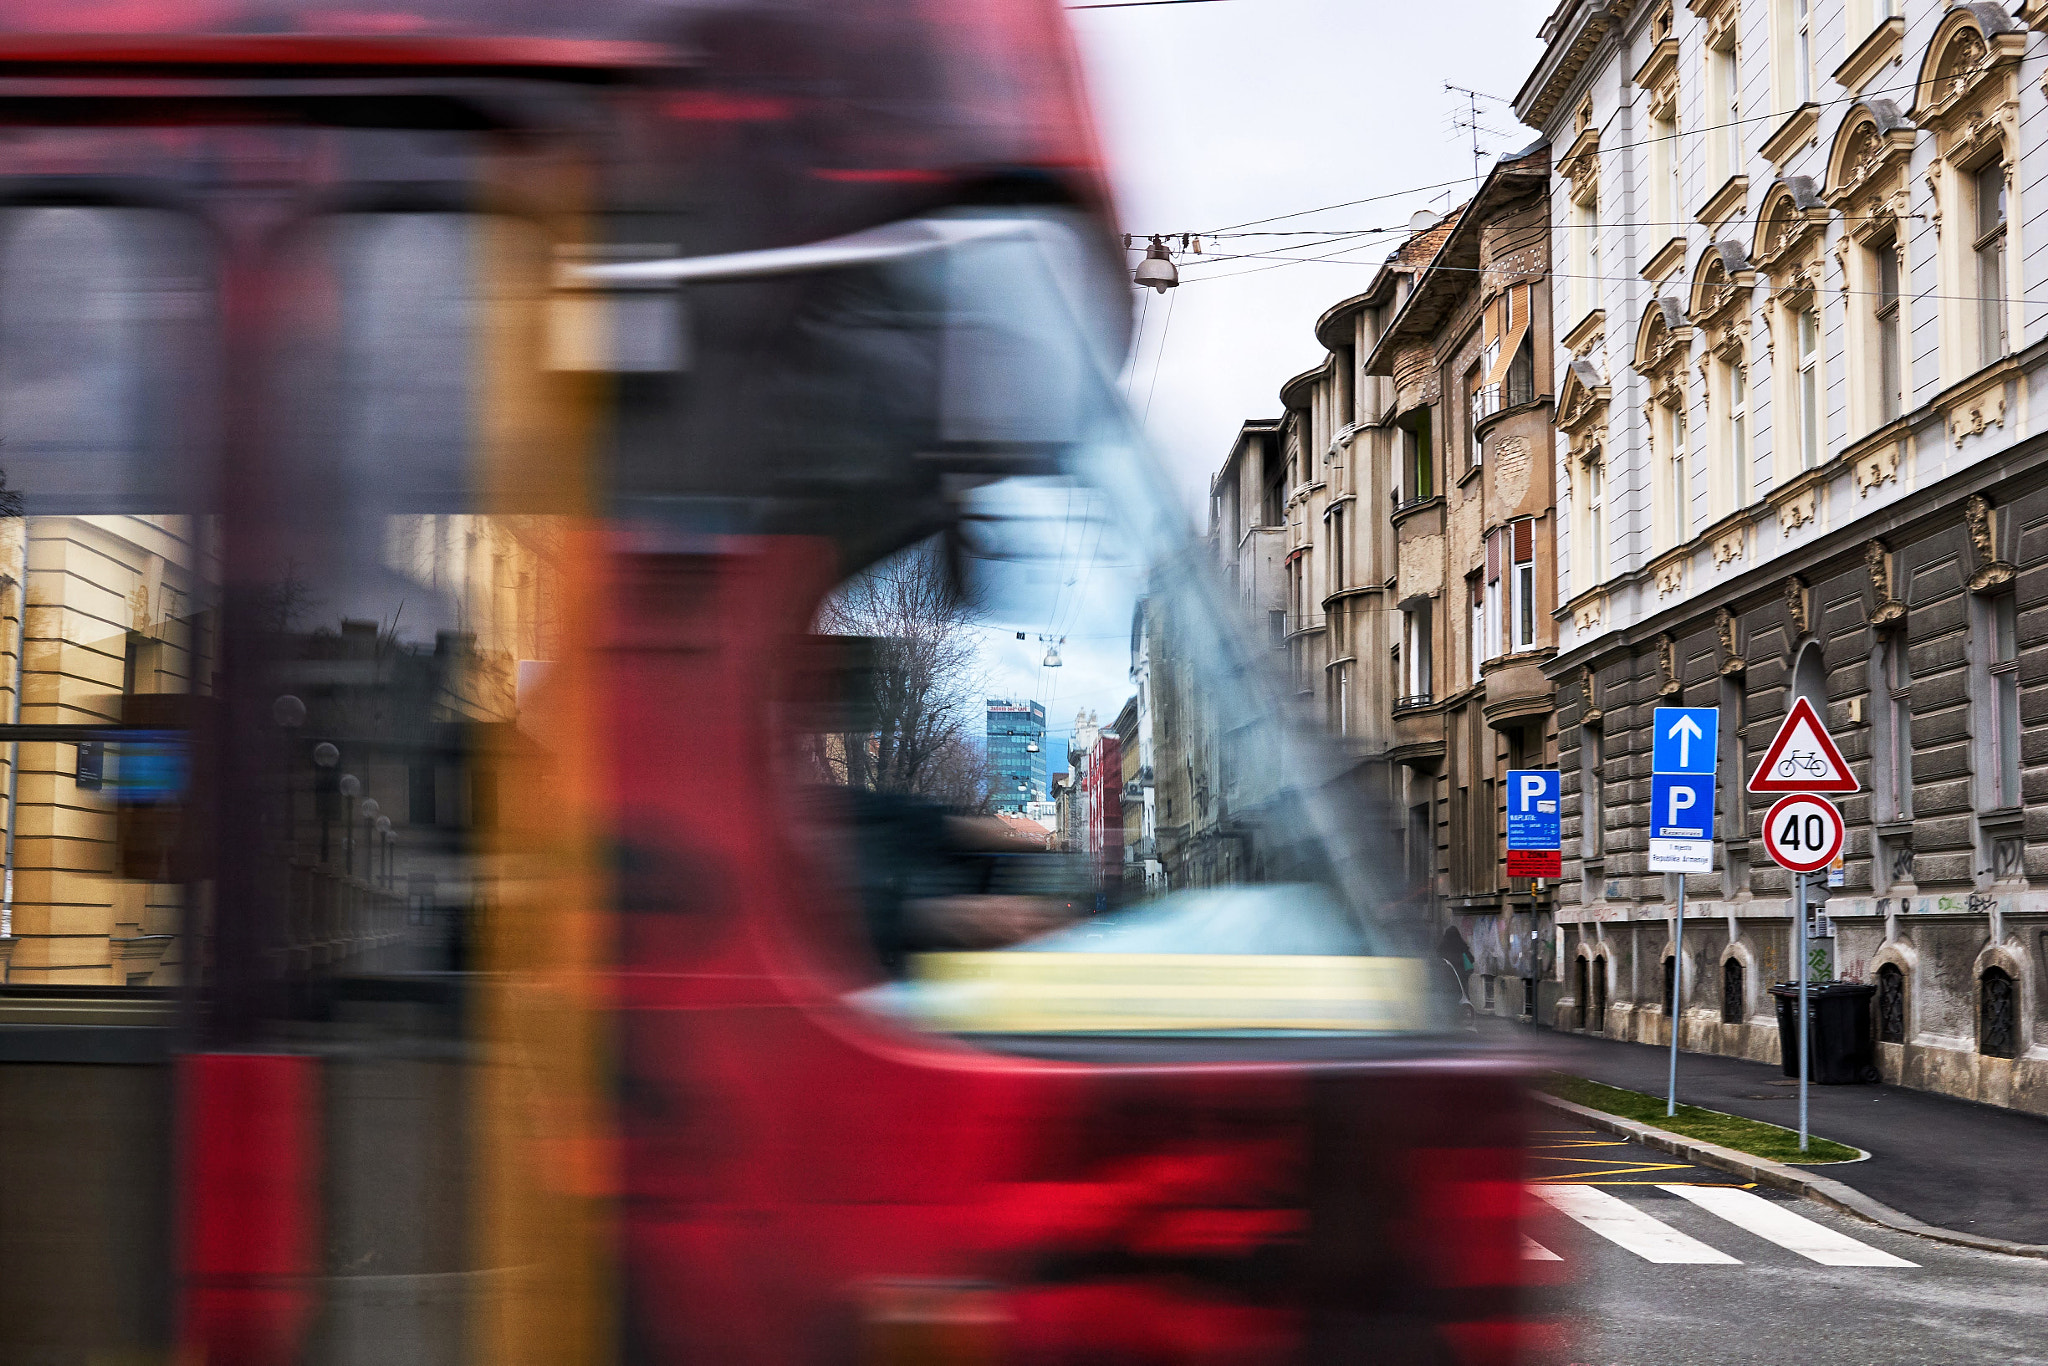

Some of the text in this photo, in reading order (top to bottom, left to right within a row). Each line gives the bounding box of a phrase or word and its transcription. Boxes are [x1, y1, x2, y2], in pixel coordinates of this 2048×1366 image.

[1521, 775, 1546, 811] P
[1668, 786, 1696, 826] P
[1780, 814, 1824, 851] 40
[1653, 854, 1709, 865] Republika Armenije
